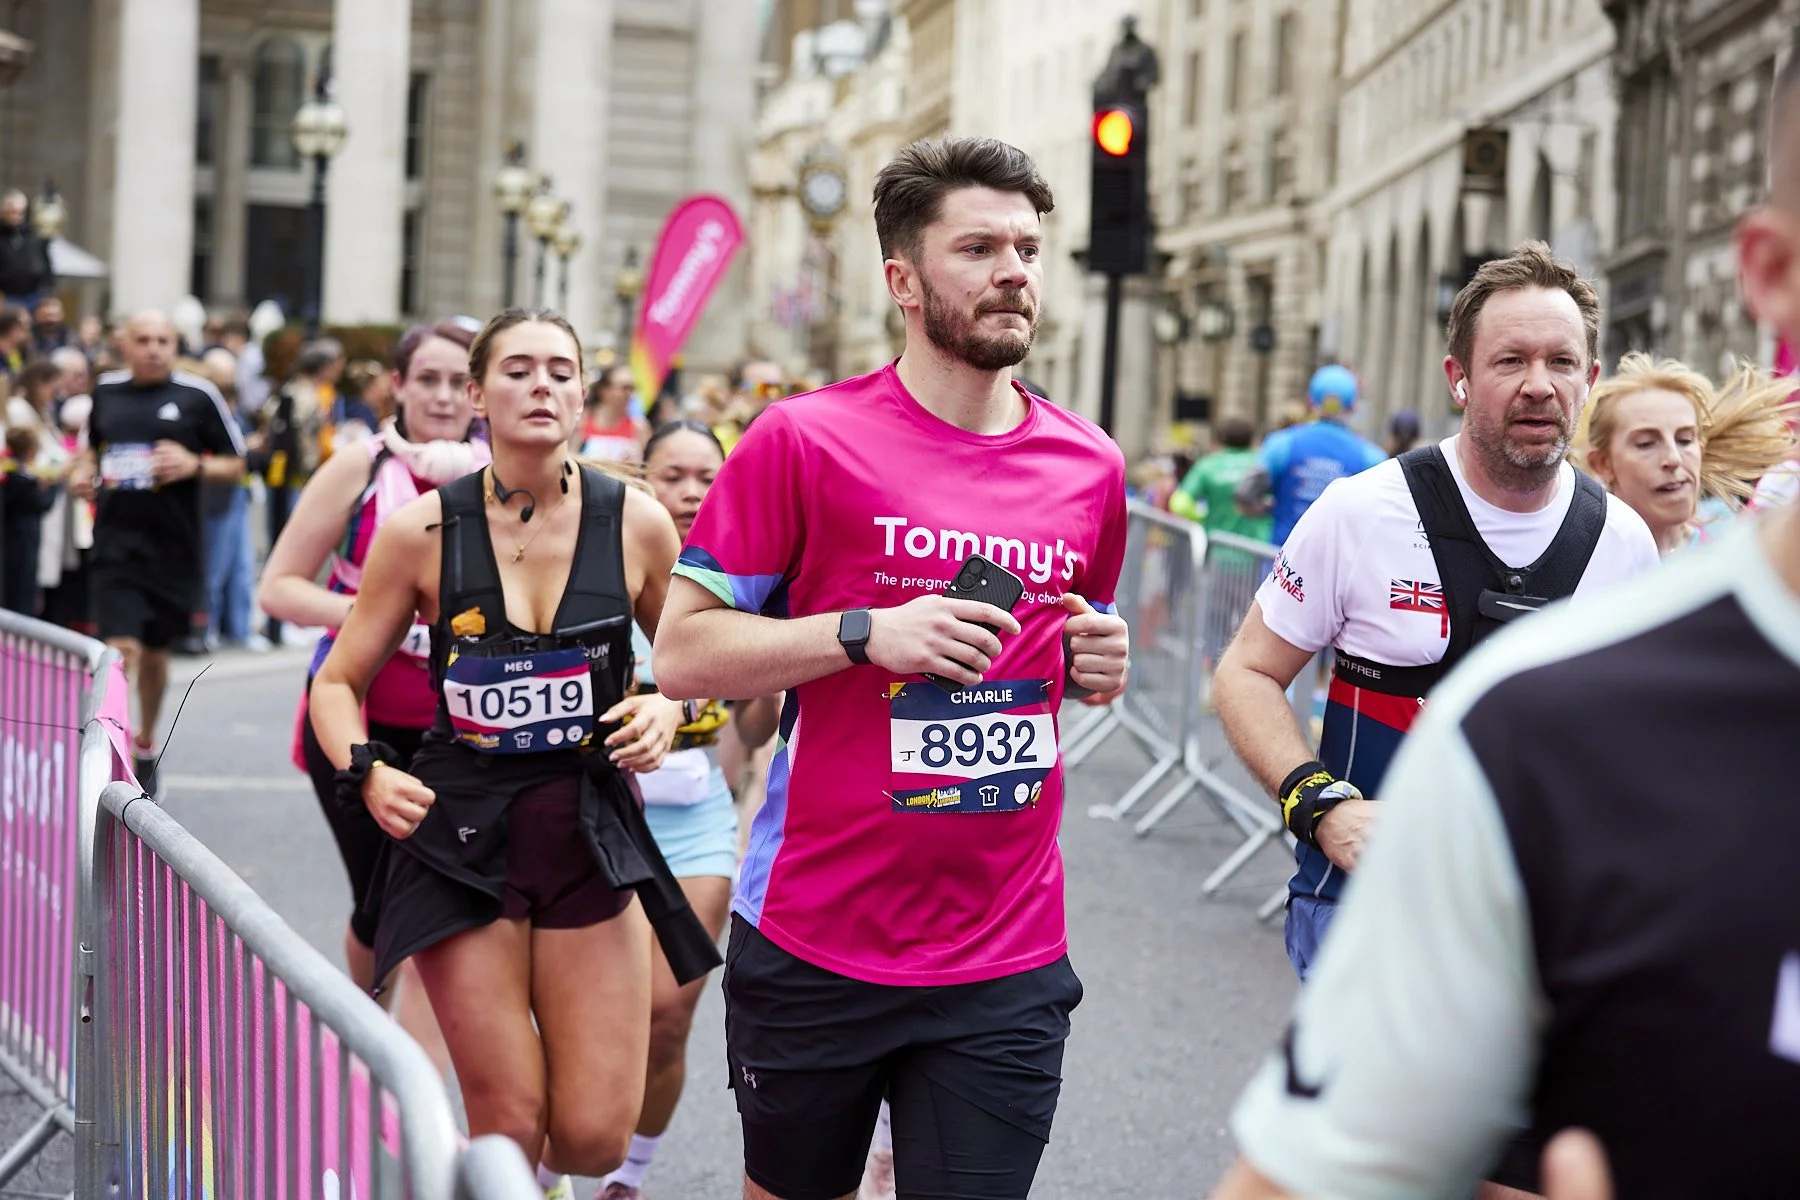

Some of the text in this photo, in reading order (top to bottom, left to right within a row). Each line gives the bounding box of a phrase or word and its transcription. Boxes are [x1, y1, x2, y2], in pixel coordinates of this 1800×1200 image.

[873, 516, 1078, 584] Tommy's
[873, 571, 898, 585] The
[1294, 576, 1304, 588] &
[504, 660, 534, 673] MEG
[1351, 664, 1382, 680] FREE
[457, 680, 583, 720] 10519
[950, 689, 1013, 705] CHARLIE
[921, 720, 1037, 768] 8932
[906, 794, 932, 806] LONDON
